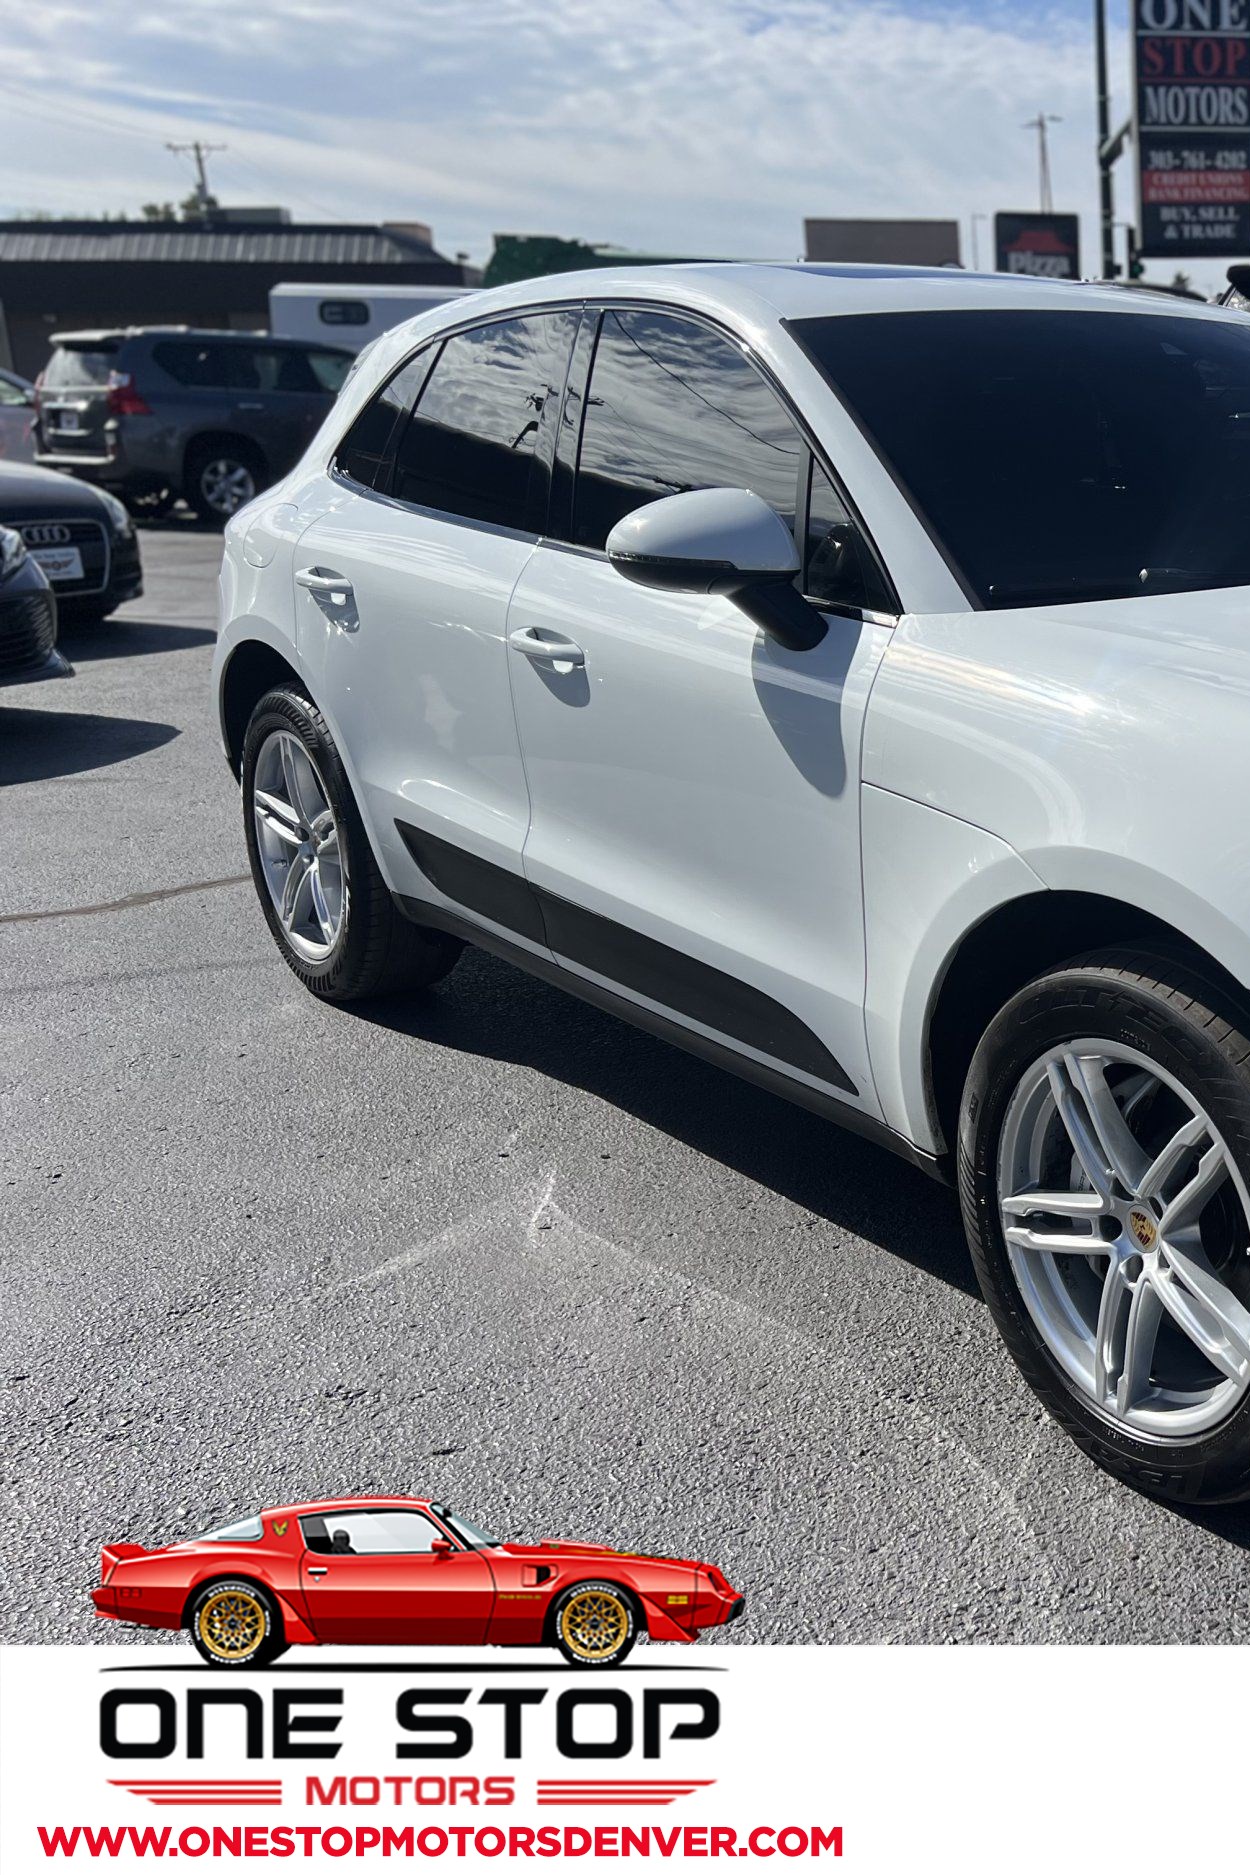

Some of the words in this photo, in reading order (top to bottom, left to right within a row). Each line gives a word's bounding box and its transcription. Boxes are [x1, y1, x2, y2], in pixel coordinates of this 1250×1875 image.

[1141, 0, 1247, 30] ONE
[1143, 37, 1247, 76] STOP
[1145, 86, 1248, 125] MOTORS
[1198, 206, 1240, 220] SELL
[1164, 224, 1178, 239] &
[1181, 224, 1236, 239] TRADE
